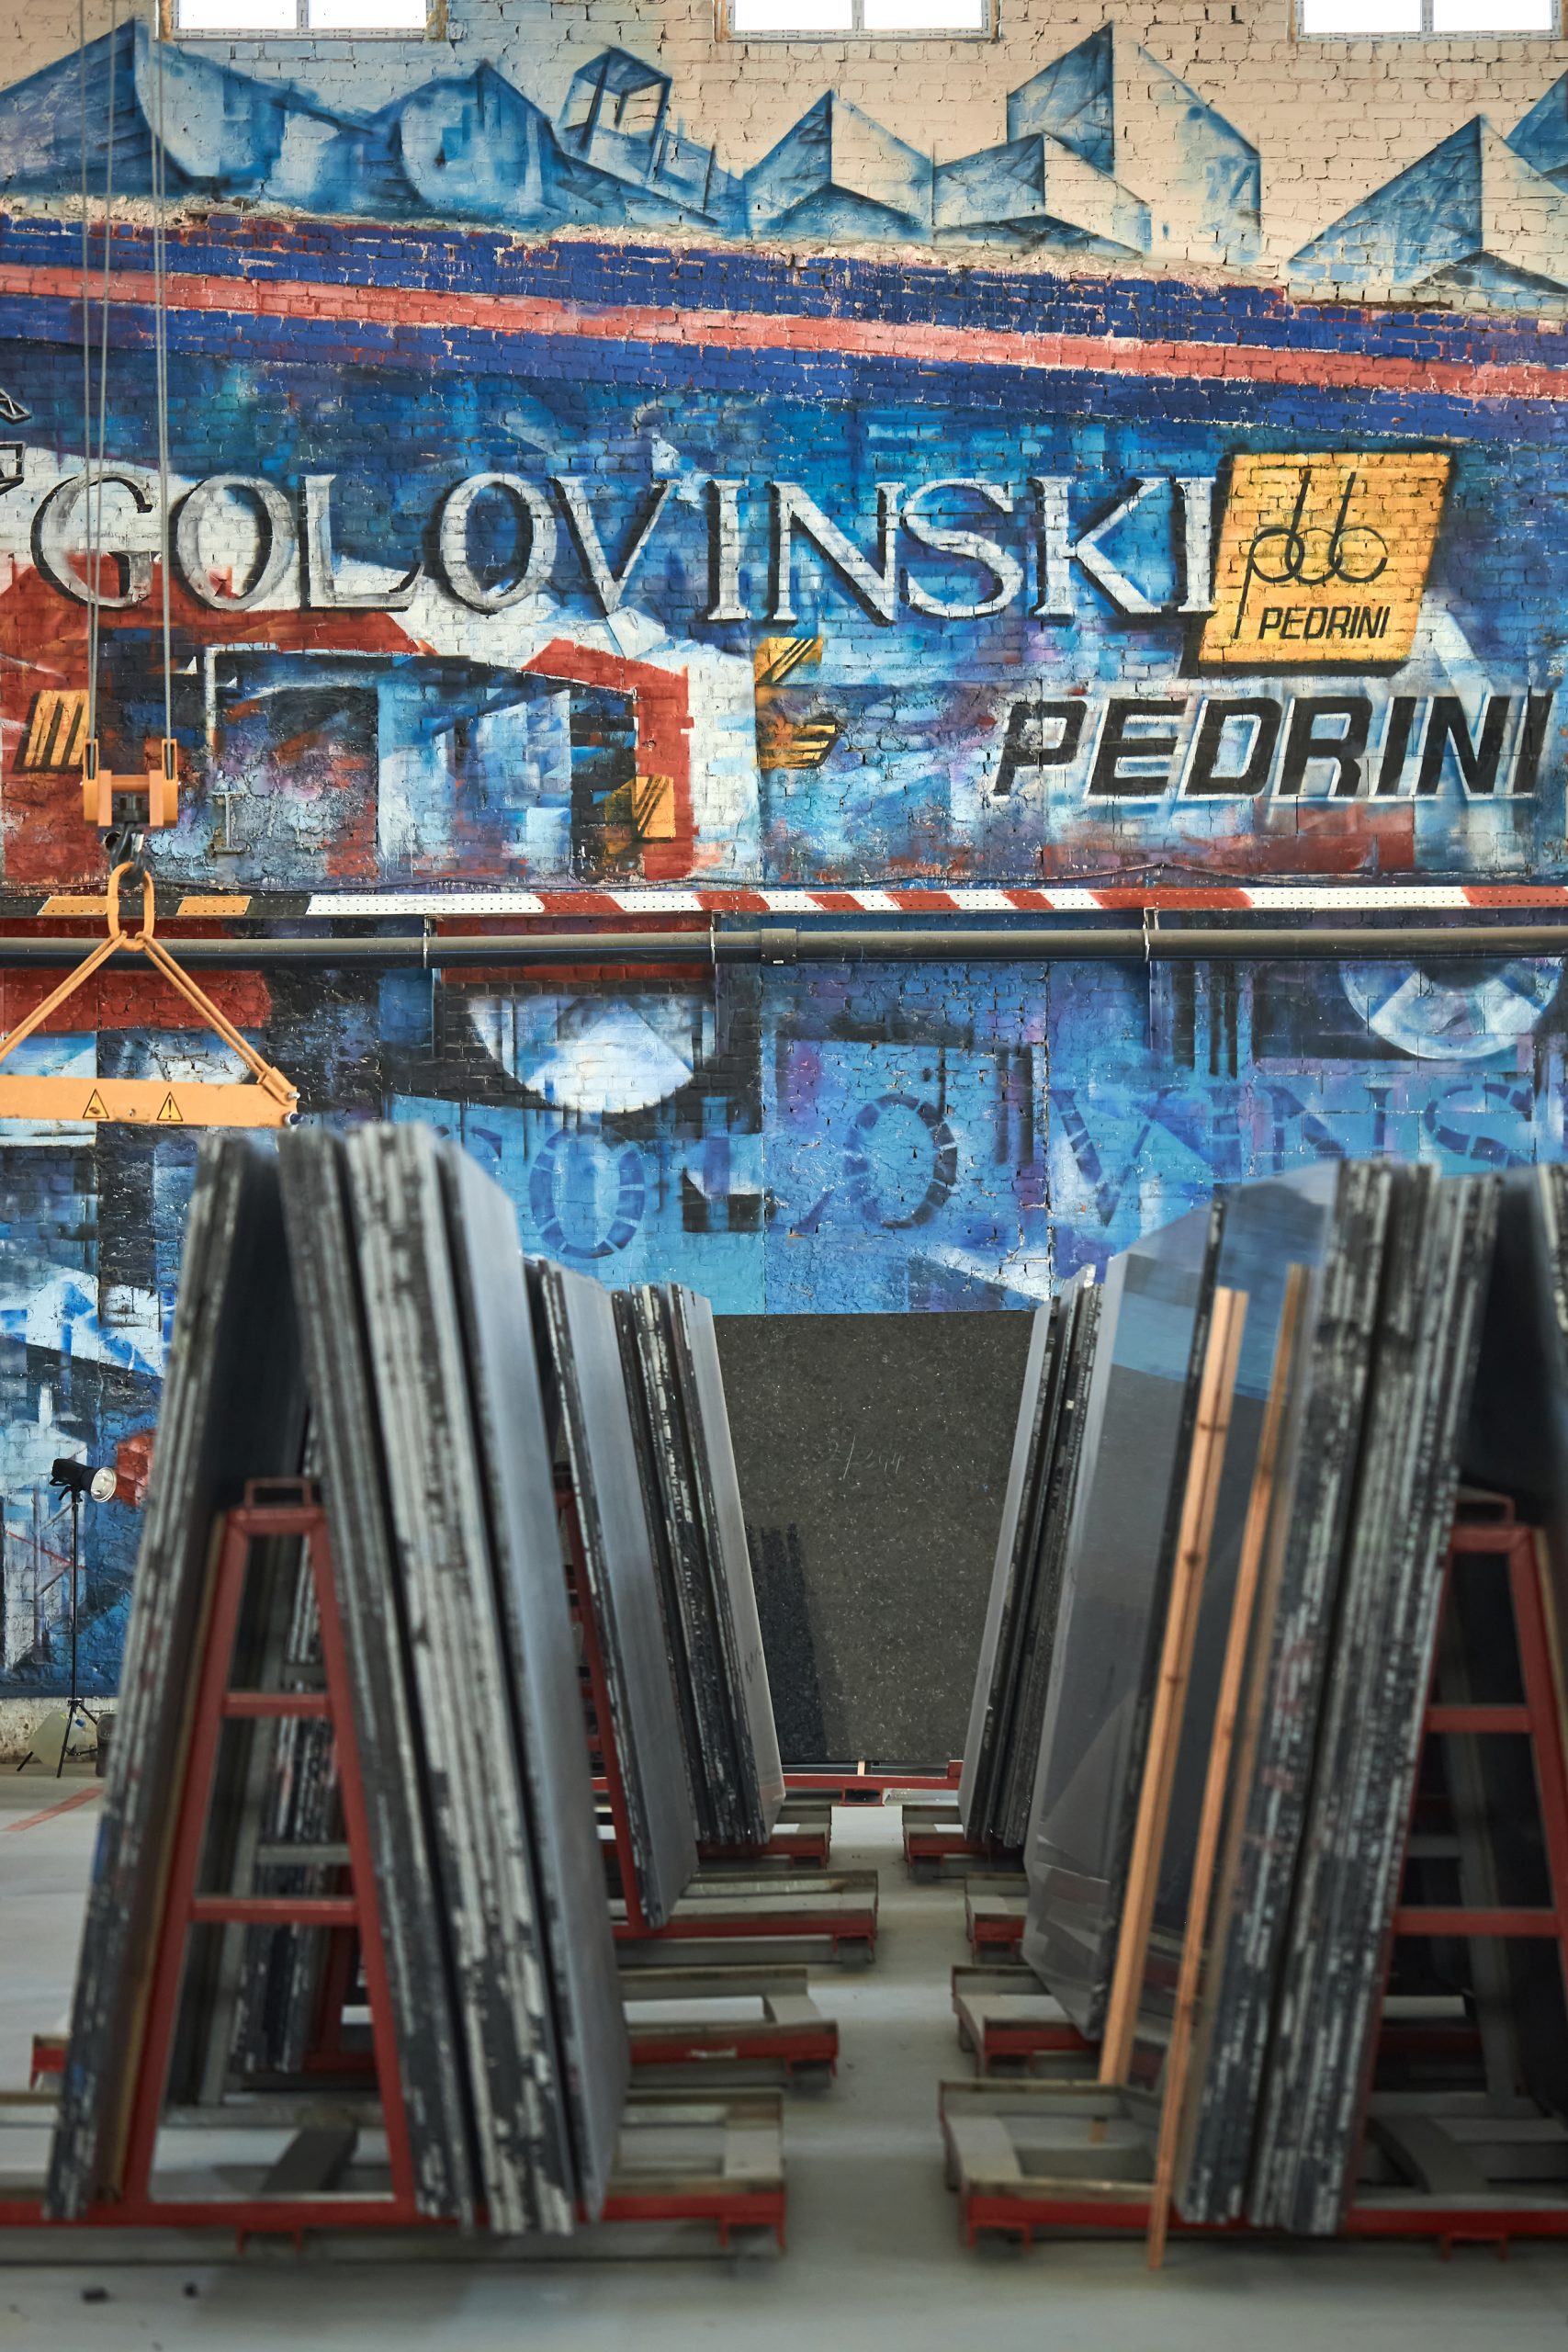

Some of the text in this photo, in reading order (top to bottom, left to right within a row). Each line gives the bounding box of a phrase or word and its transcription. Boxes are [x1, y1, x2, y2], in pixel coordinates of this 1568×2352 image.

[30, 469, 1218, 625] GOLOVINSKI
[1258, 605, 1391, 640] PEDRINI
[988, 687, 1554, 802] PEDRINI
